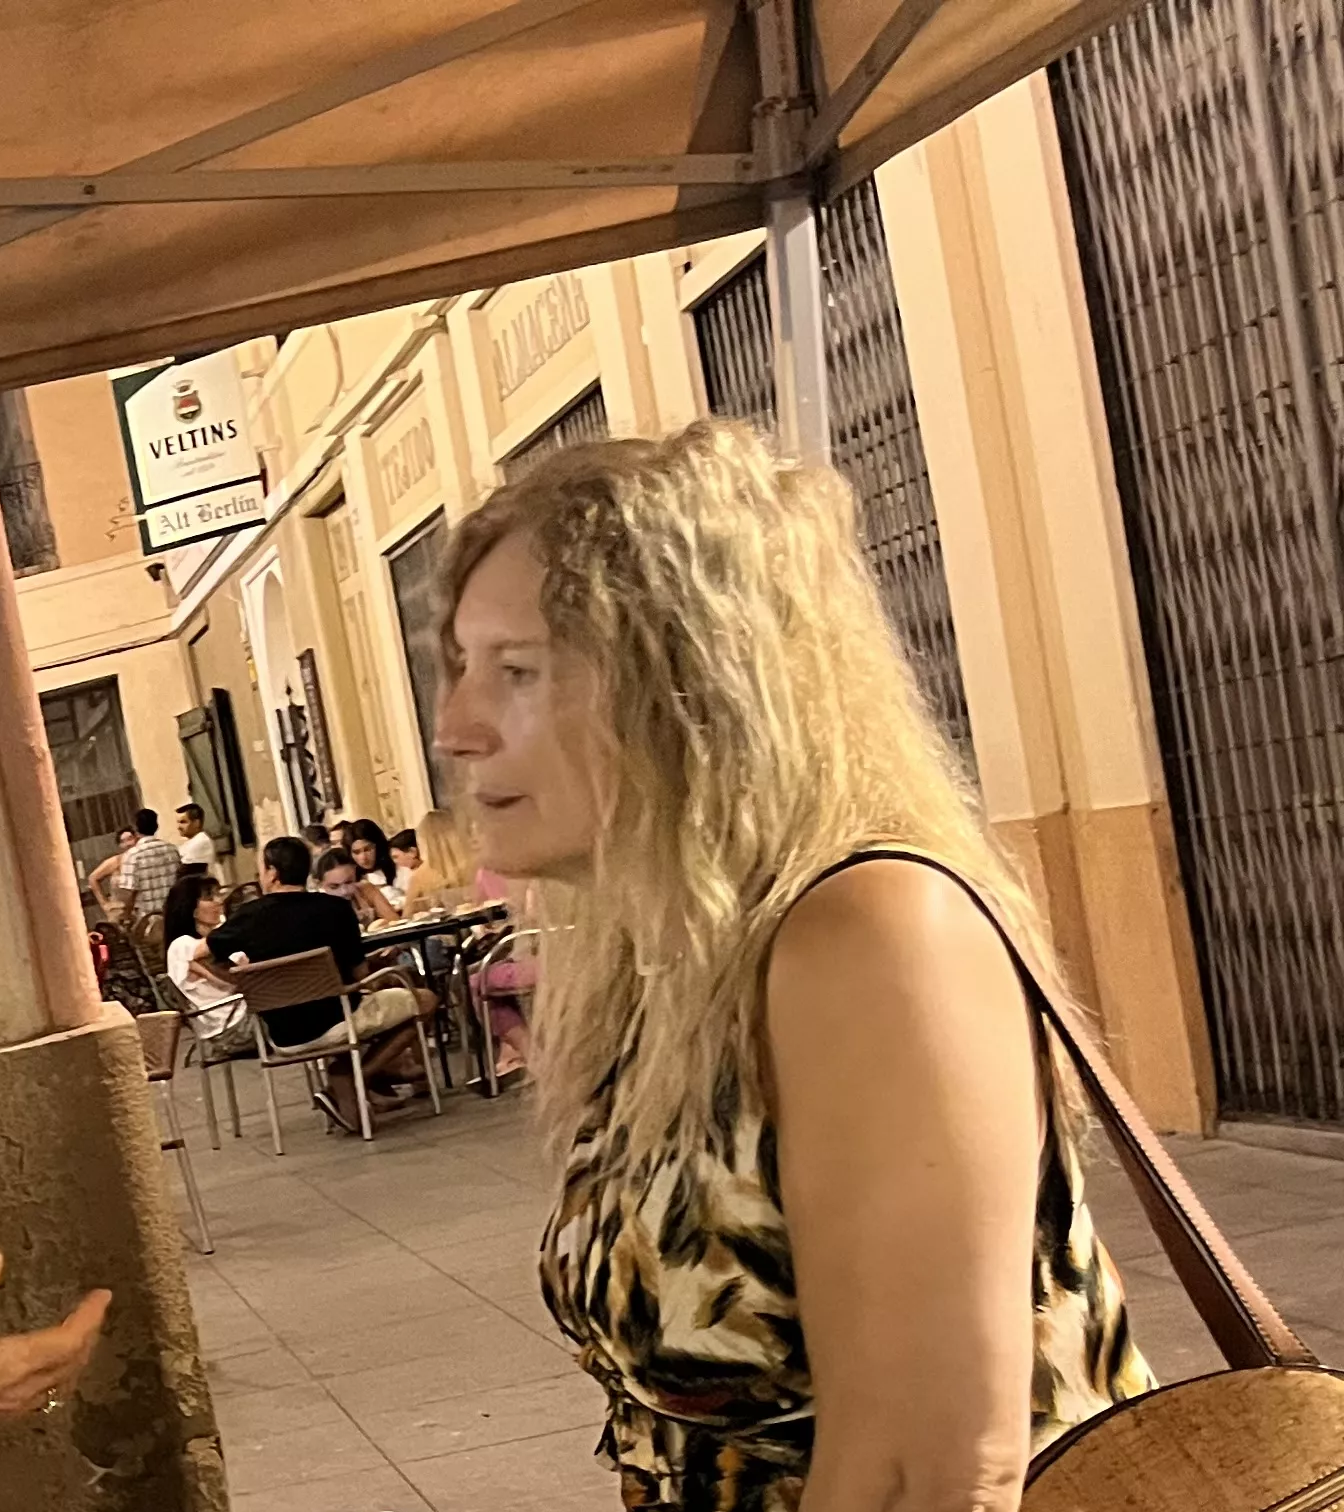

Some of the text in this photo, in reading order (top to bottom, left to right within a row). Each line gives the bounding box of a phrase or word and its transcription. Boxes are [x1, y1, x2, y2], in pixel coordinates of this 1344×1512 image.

[149, 419, 238, 459] VELTINS
[159, 495, 259, 536] Alt Berlin
